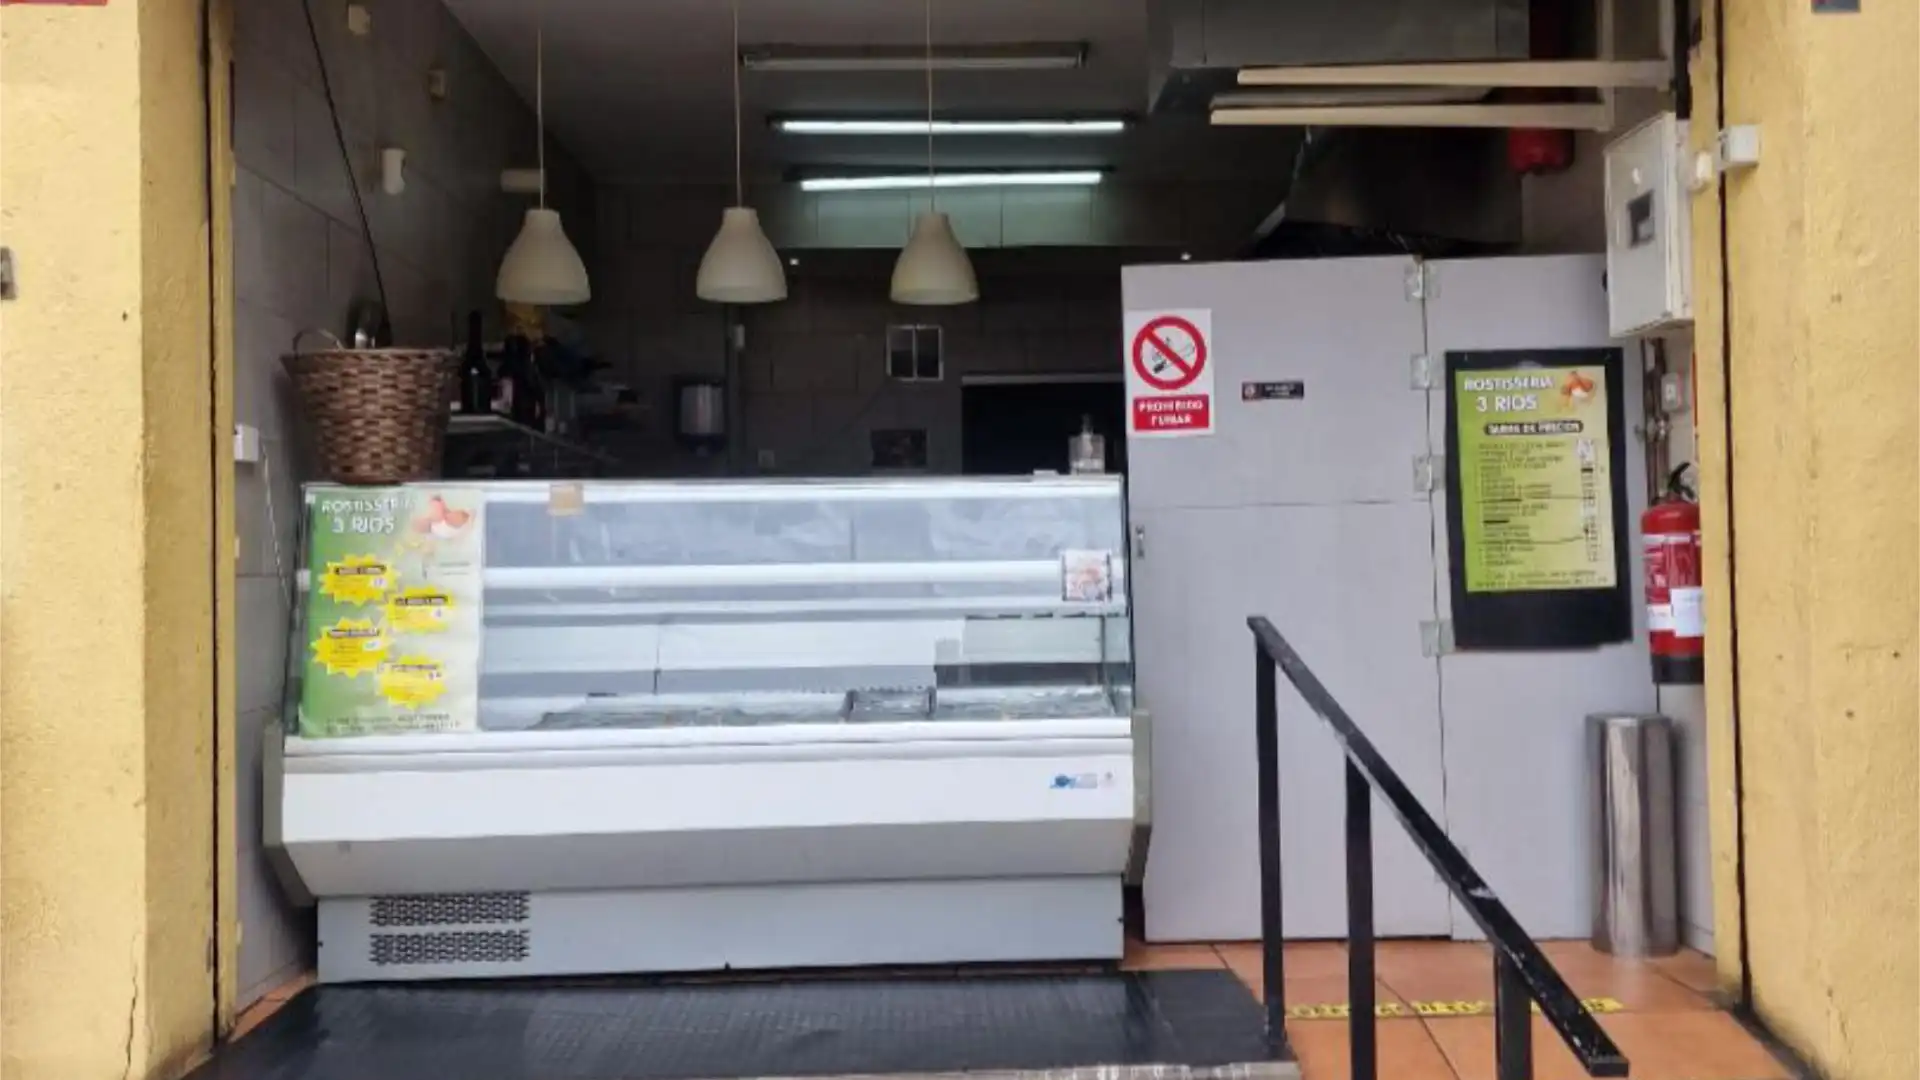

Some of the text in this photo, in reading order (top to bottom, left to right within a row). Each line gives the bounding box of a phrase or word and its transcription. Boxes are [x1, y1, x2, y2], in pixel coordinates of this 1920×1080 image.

[1139, 400, 1203, 412] PROHIBIDO
[1476, 395, 1538, 412] 3 RIOS
[1151, 413, 1192, 427] FUMAR
[352, 516, 395, 533] RIOS
